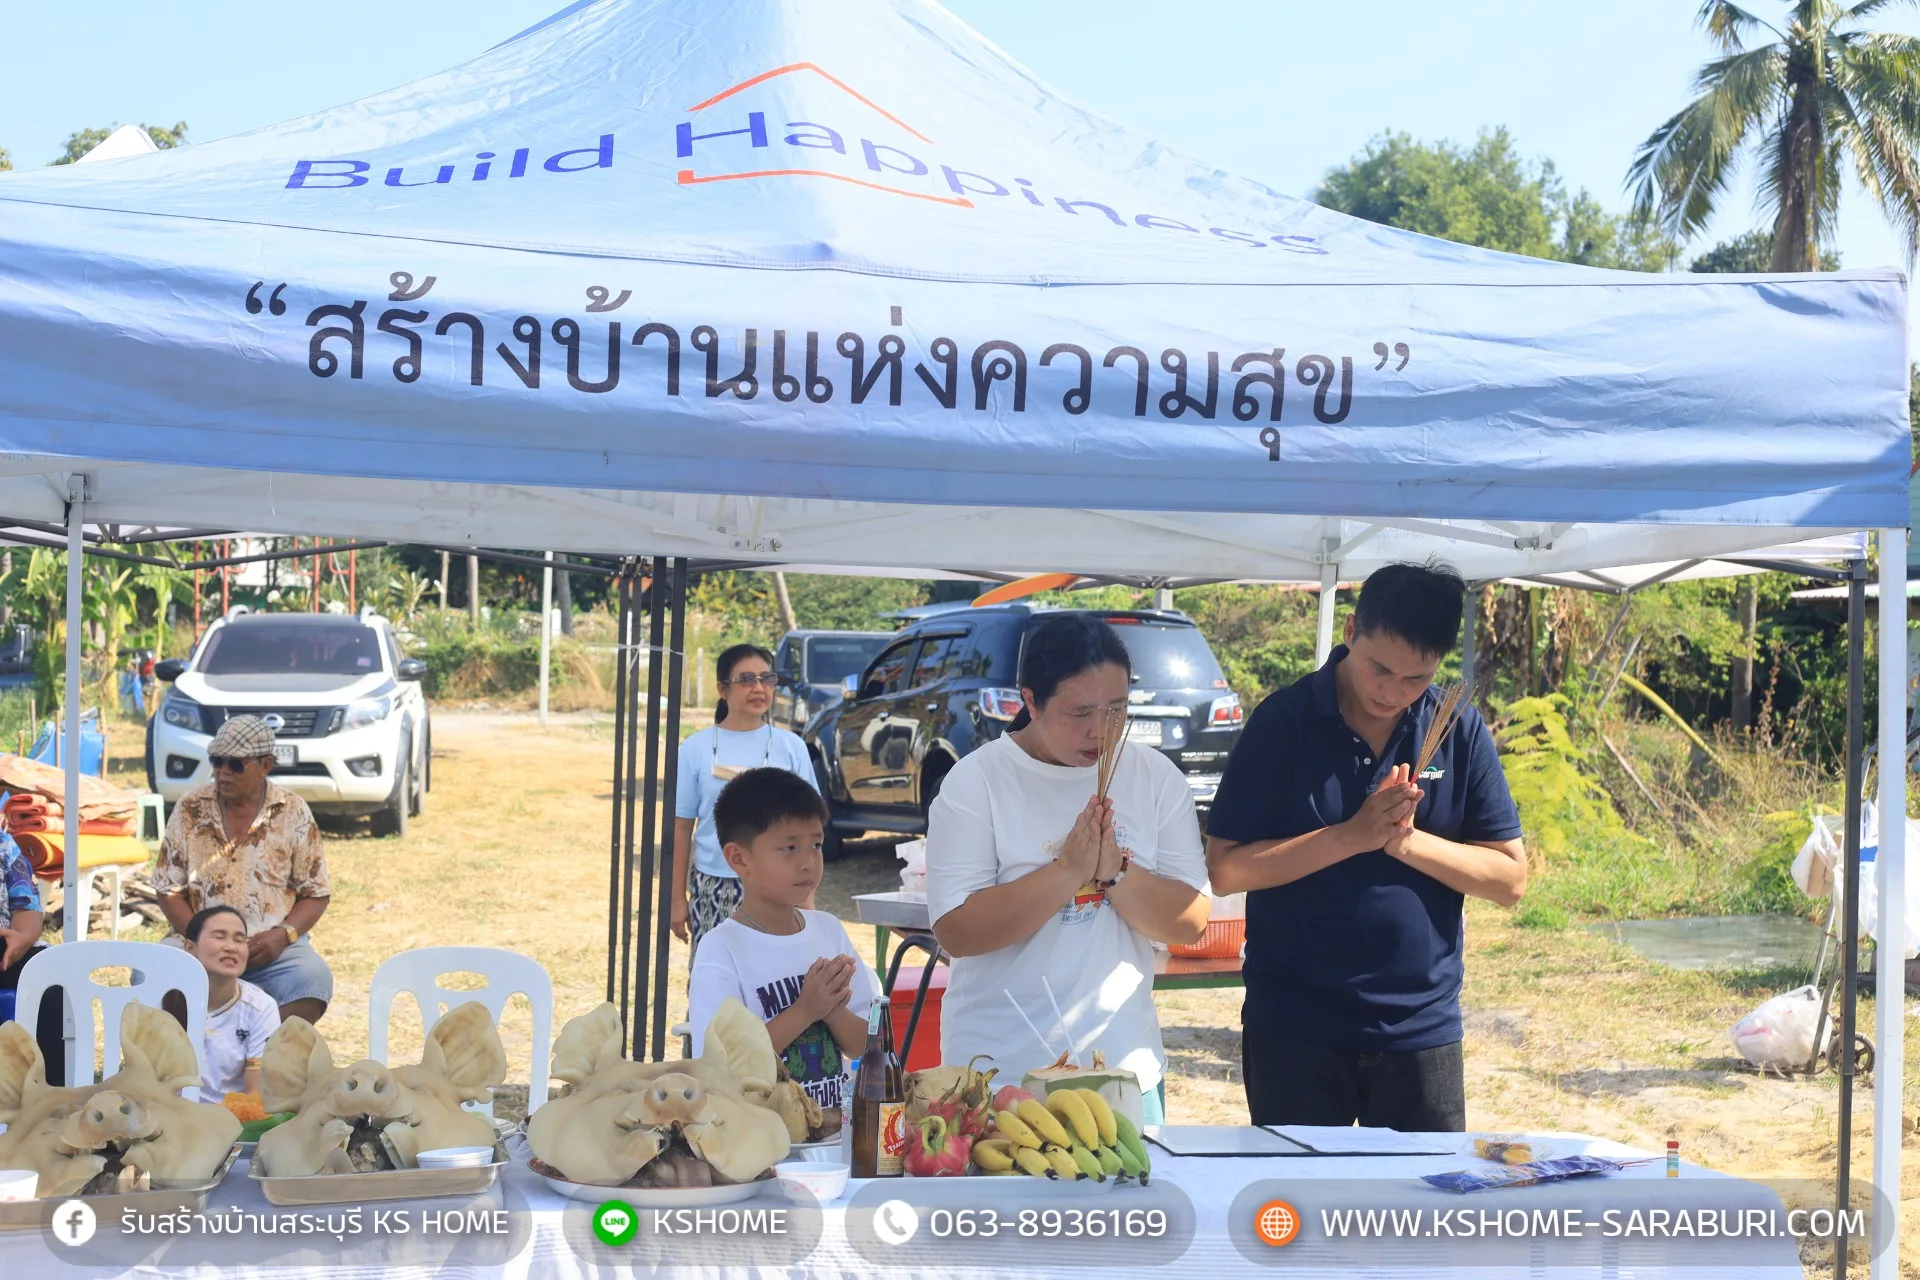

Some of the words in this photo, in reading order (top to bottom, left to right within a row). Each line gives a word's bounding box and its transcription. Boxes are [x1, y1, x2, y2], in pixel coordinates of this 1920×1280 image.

[284, 133, 614, 189] Build
[676, 111, 1329, 255] Happiness
[244, 271, 1410, 462] “สร้างบ้านแห่งความสุข”
